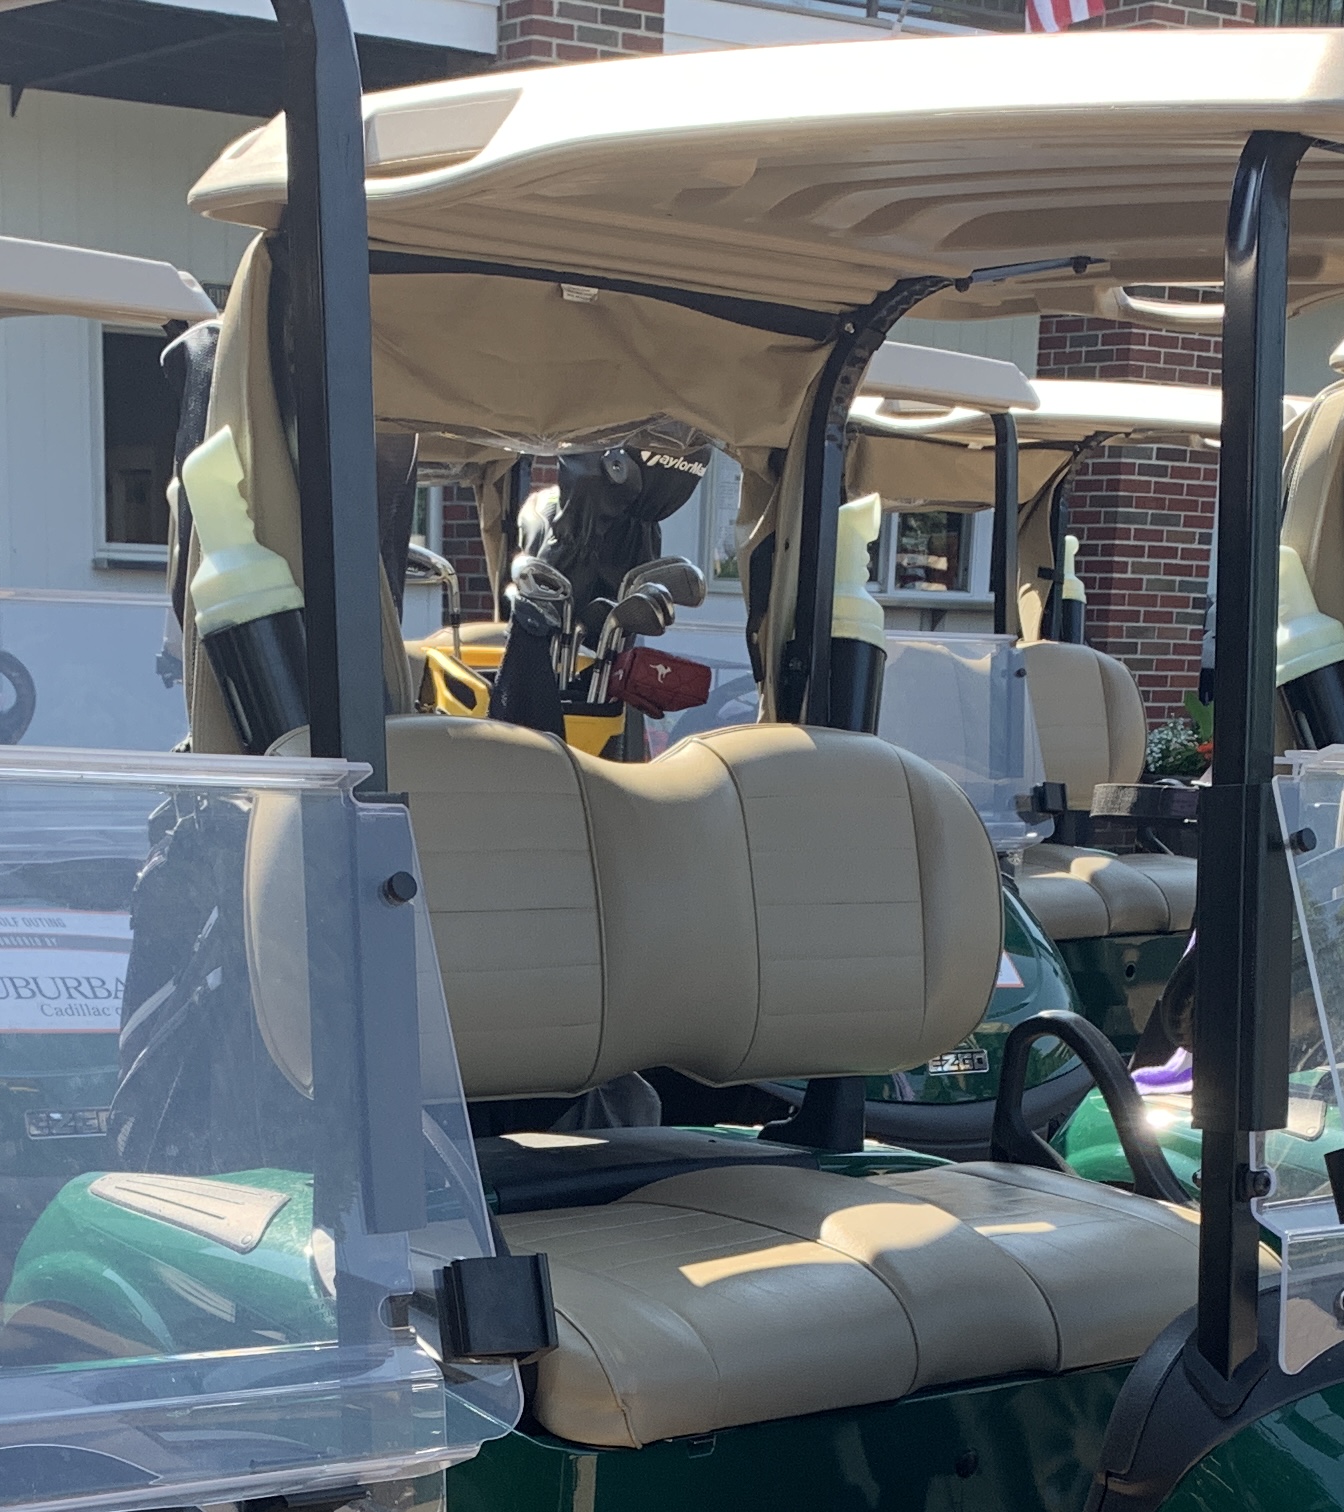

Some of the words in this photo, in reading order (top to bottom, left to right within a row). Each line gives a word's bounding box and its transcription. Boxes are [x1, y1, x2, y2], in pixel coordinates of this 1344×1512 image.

[640, 450, 708, 477] TaylorMa
[21, 917, 67, 929] OUTING
[40, 1003, 111, 1017] Cadillac
